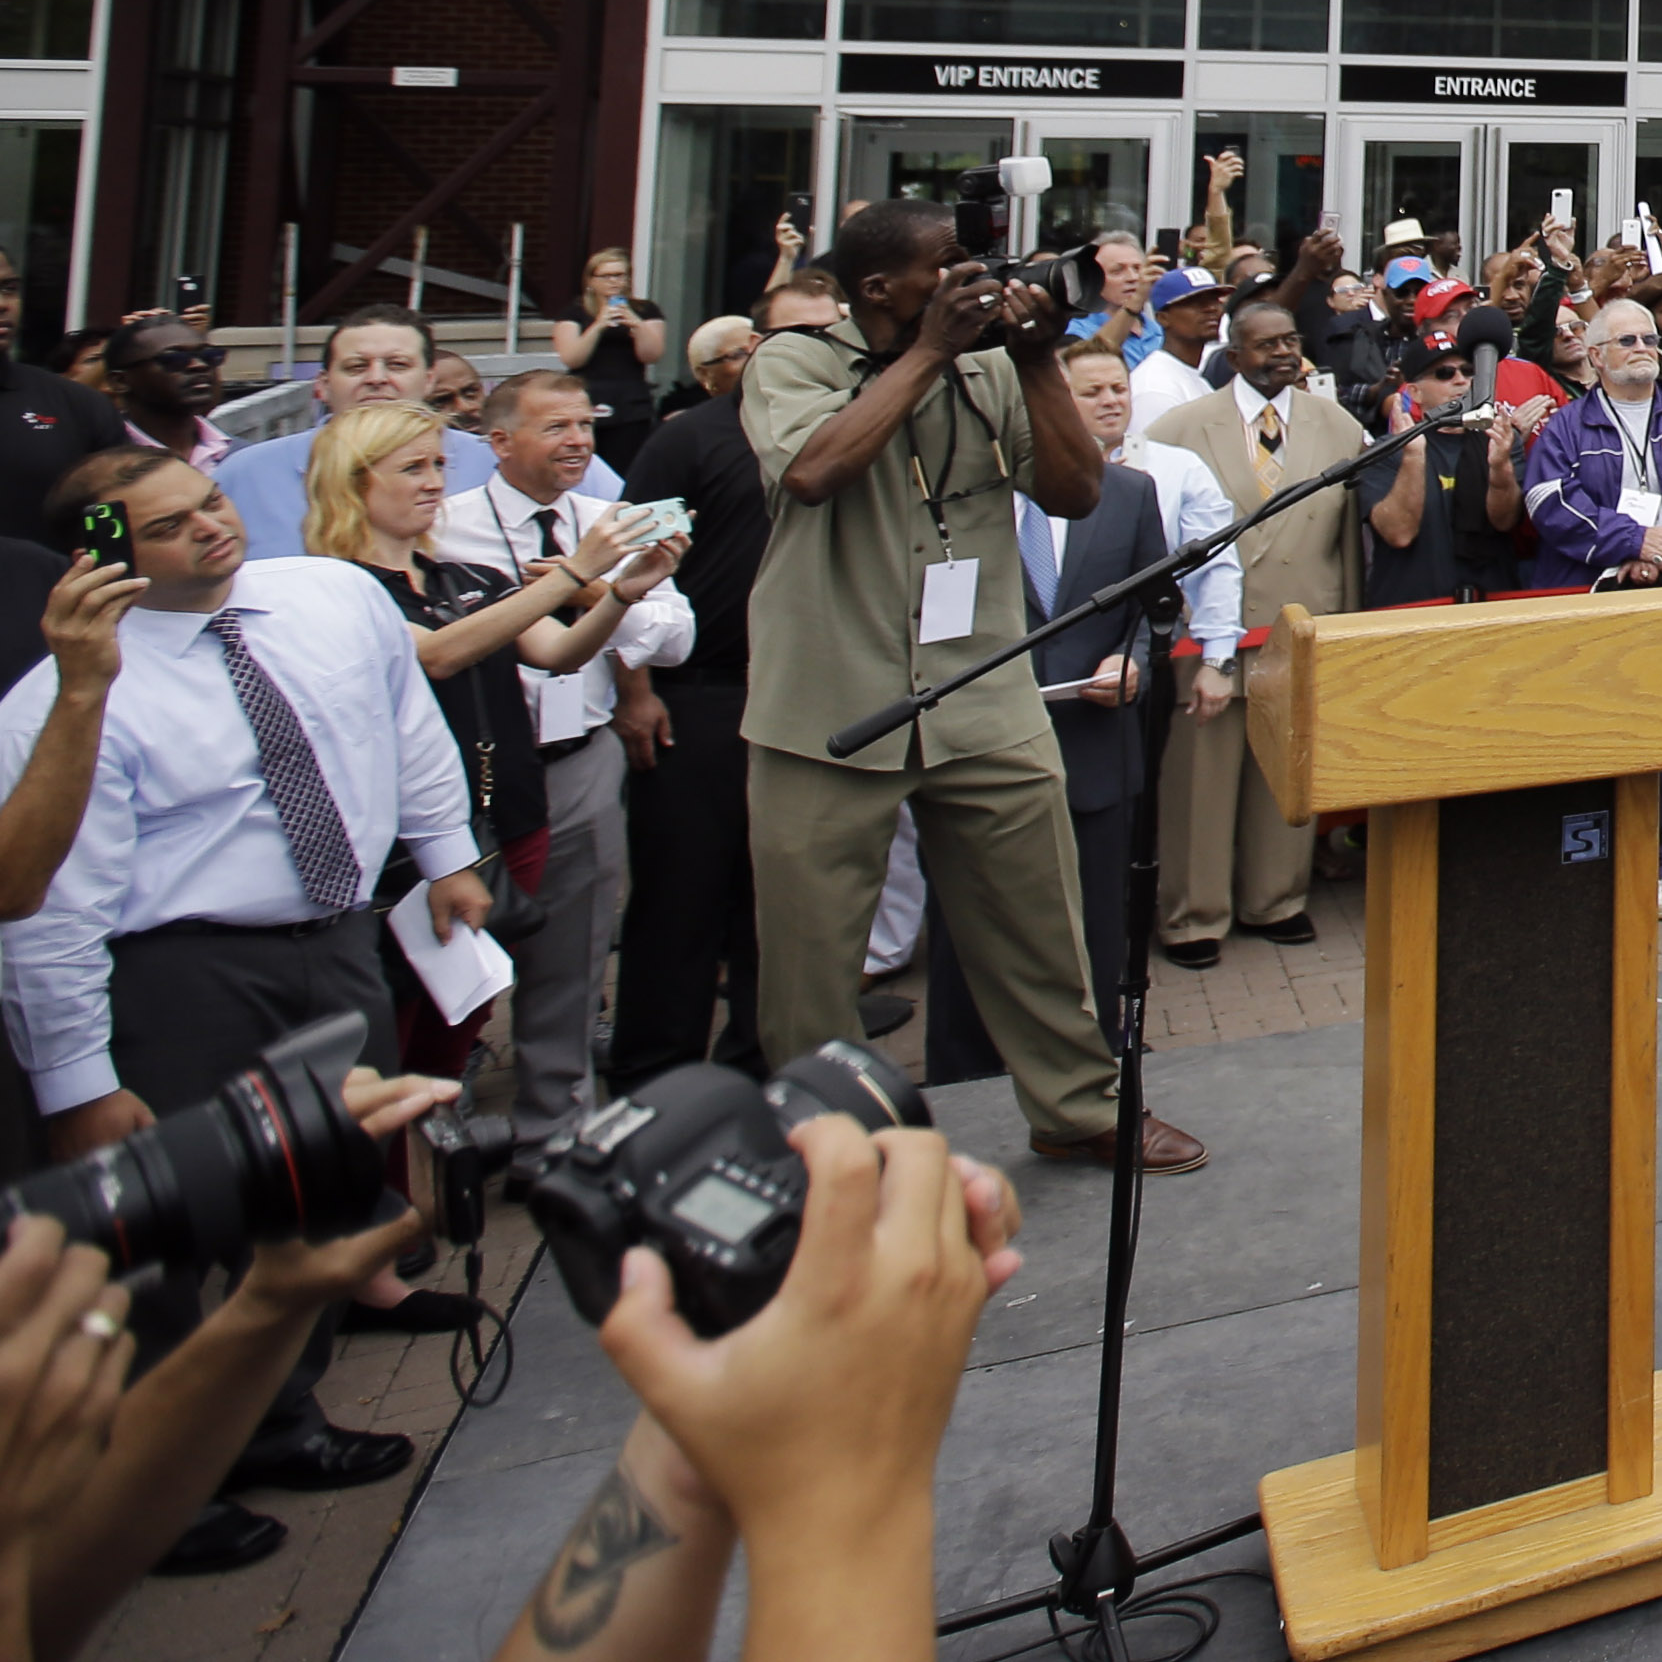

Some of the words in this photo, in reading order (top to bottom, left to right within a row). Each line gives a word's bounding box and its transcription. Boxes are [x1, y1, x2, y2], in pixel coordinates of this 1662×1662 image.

[934, 65, 976, 88] VIP
[978, 65, 1101, 88] ENTRANCE
[1434, 76, 1536, 98] ENTRANCE
